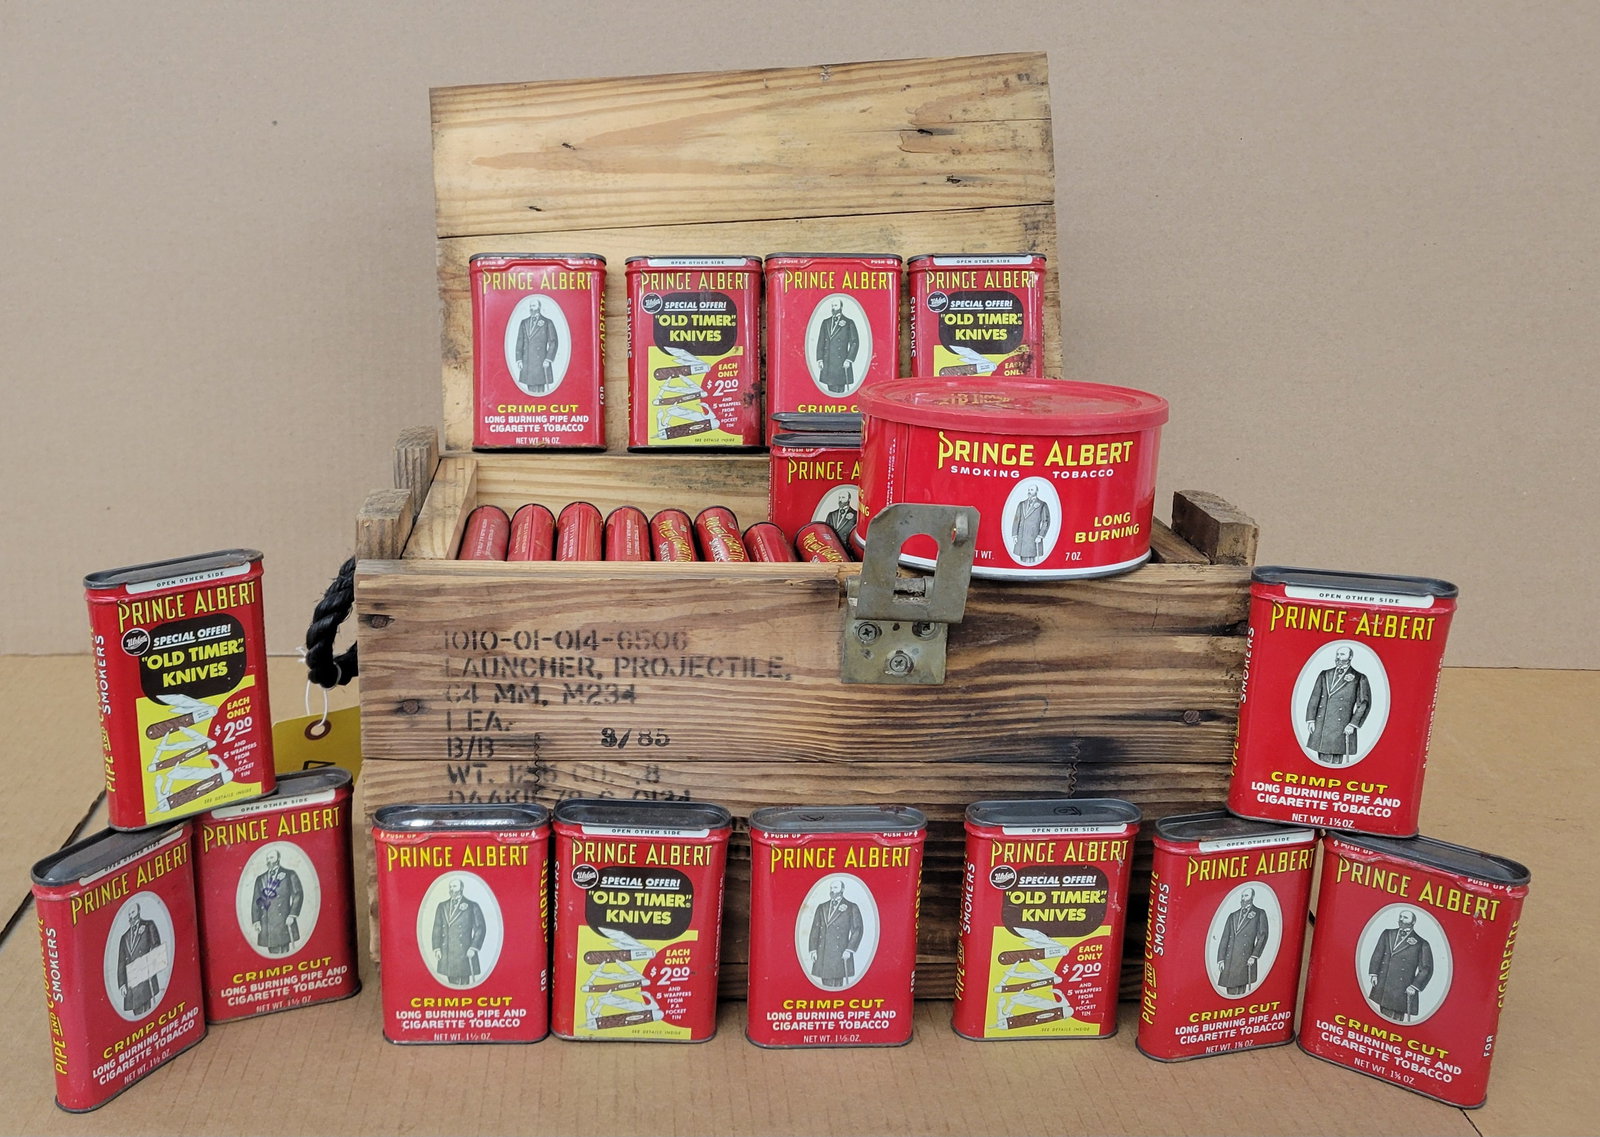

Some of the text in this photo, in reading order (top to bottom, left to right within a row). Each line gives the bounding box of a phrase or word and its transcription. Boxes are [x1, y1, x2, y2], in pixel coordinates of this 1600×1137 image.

[482, 268, 592, 294] PRINCE ALBERT
[640, 268, 749, 294] PRINCE ALBERT
[785, 268, 893, 294] PRINCE ALBERT
[925, 268, 1035, 294] PRINCE ALBERT
[670, 330, 722, 343] KNIVES
[955, 328, 1008, 341] KNIVES
[484, 416, 547, 424] LONG BURNING
[497, 404, 578, 414] CRIMP CUT
[490, 424, 584, 433] CIGARETTE TOBACCO
[938, 431, 1134, 470] PRINCE ALBERT
[788, 457, 844, 484] PRINCE
[950, 465, 1115, 480] SMOKING TOBACCO
[1094, 512, 1132, 528] LONG
[1074, 524, 1141, 544] BURNING
[1065, 552, 1070, 561] 7
[156, 571, 225, 588] OPEN OTHER SIDE
[118, 582, 257, 633] PRINCE ALBERT
[1318, 592, 1342, 600] OPEN
[1345, 594, 1375, 602] OTHER
[1270, 599, 1436, 642] PRINCE ALBERT
[154, 632, 196, 647] SPECIAL
[198, 624, 232, 640] OFFER!
[142, 648, 188, 670] "OLD
[445, 656, 792, 680] LAUNCHER, PROJECTILE,
[1240, 626, 1256, 704] SMOKERS
[96, 634, 112, 716] SMOKERS
[162, 662, 229, 688] KNIVES
[226, 697, 251, 711] EACH
[226, 706, 252, 720] ONLY
[234, 762, 255, 775] POCKET
[240, 770, 251, 778] TIN
[1251, 781, 1401, 808] LONG BURNING PIPE AND
[1271, 771, 1389, 795] CRIMP CUT
[1256, 793, 1391, 818] CIGARETTE TOBACCO
[202, 807, 342, 853] PRINCE ALBERT
[1292, 812, 1308, 824] NET
[1310, 814, 1327, 826] WT.
[1342, 818, 1356, 830] OZ.
[386, 844, 529, 872] PRINCE ALBERT
[572, 838, 713, 866] PRINCE ALBERT
[770, 844, 912, 873] PRINCE ALBERT
[991, 840, 1130, 866] PRINCE ALBERT
[1186, 848, 1316, 888] PRINCE ALBERT
[70, 872, 130, 926] PRINCE
[136, 842, 188, 888] ALBERT
[600, 876, 643, 886] SPECIAL
[645, 878, 680, 888] OFFER!
[1018, 876, 1096, 886] SPECIAL OFFER!
[1337, 853, 1501, 922] PRINCE ALBERT
[588, 890, 630, 906] "OLD
[1006, 890, 1053, 904] "OLD
[606, 910, 672, 925] KNIVES
[1022, 908, 1086, 922] KNIVES
[1152, 882, 1171, 957] SMOKERS
[1077, 952, 1102, 961] ONLY
[1078, 944, 1103, 953] EACH
[232, 956, 332, 985] CRIMP CUT
[220, 974, 298, 998] LONG BURNING
[228, 976, 343, 1007] CIGARETTE TOBACCO
[396, 1008, 527, 1020] LONG BURNING PIPE AND
[410, 996, 514, 1008] CRIMP CUT
[782, 999, 885, 1010] CRIMP CUT
[1142, 985, 1158, 1026] PIPE
[1188, 1001, 1280, 1024] CRIMP CUT
[402, 1018, 520, 1030] CIGARETTE TOBACCO
[766, 1010, 896, 1020] LONG BURNING PIPE AND
[772, 1020, 890, 1031] CIGARETTE TOBACCO
[1175, 1010, 1291, 1036] LONG BURNING PIPE AND
[103, 1001, 187, 1060] CRIMP CUT
[1180, 1022, 1284, 1045] CIGARETTE TOBACCO
[1334, 1014, 1450, 1060] CRIMP CUT
[92, 1006, 199, 1080] LONG BURNING PIPE AND
[100, 1020, 195, 1086] CIGARETTE TOBACCO
[1316, 1019, 1463, 1076] LONG BURNING PIPE AND
[1321, 1030, 1452, 1084] CIGARETTE TOBACCO
